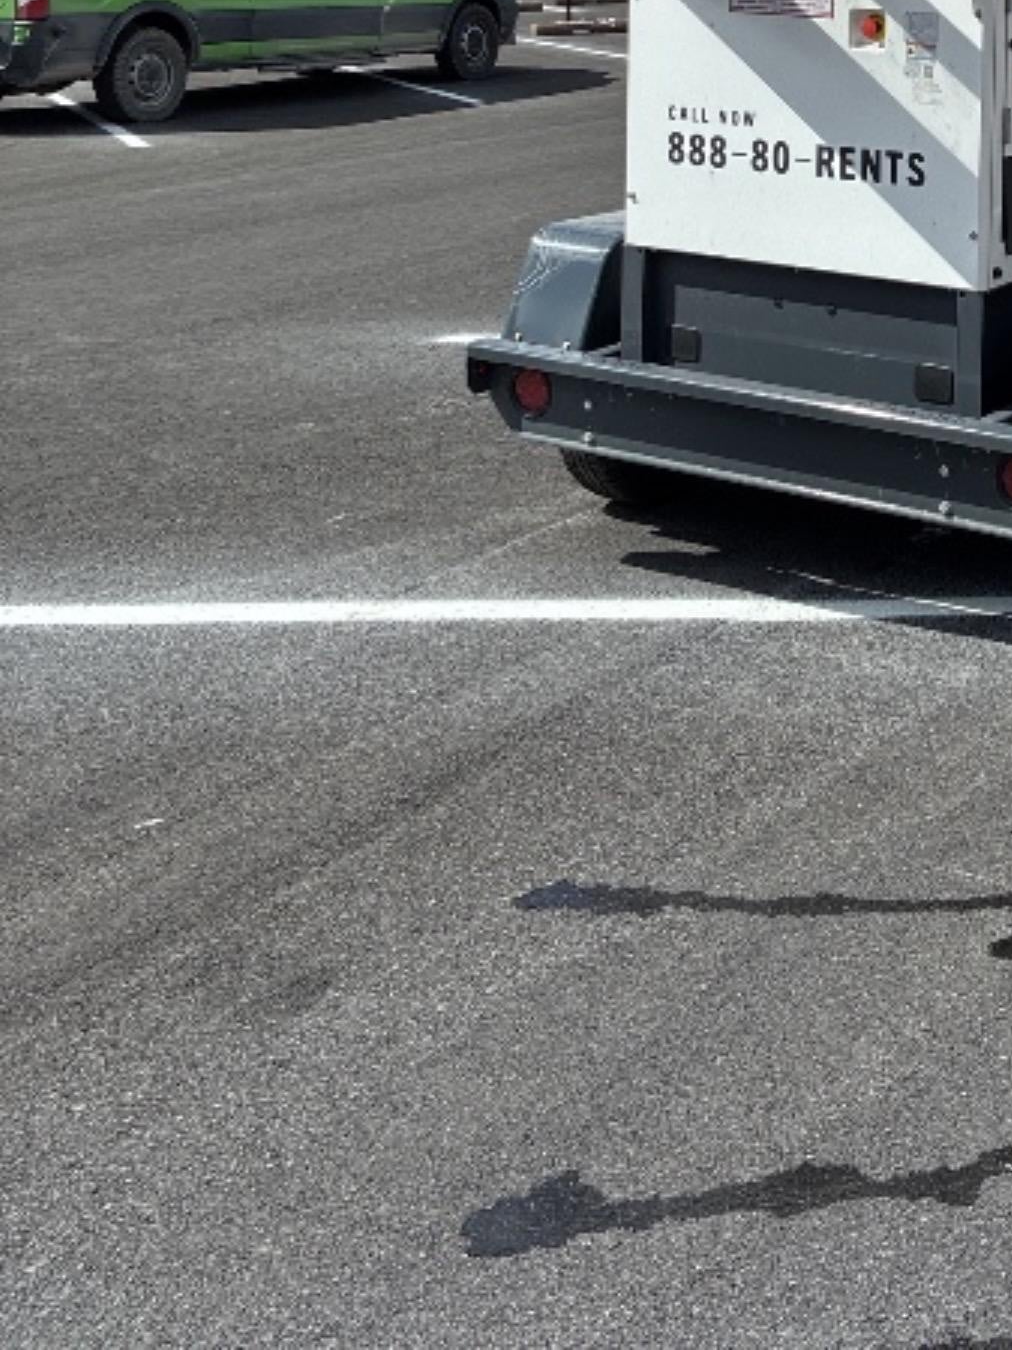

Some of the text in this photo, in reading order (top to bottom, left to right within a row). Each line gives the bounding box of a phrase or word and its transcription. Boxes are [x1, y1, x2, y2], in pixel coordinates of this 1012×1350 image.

[668, 104, 755, 128] CALL NOW
[667, 131, 926, 188] 888-80-RENTS
